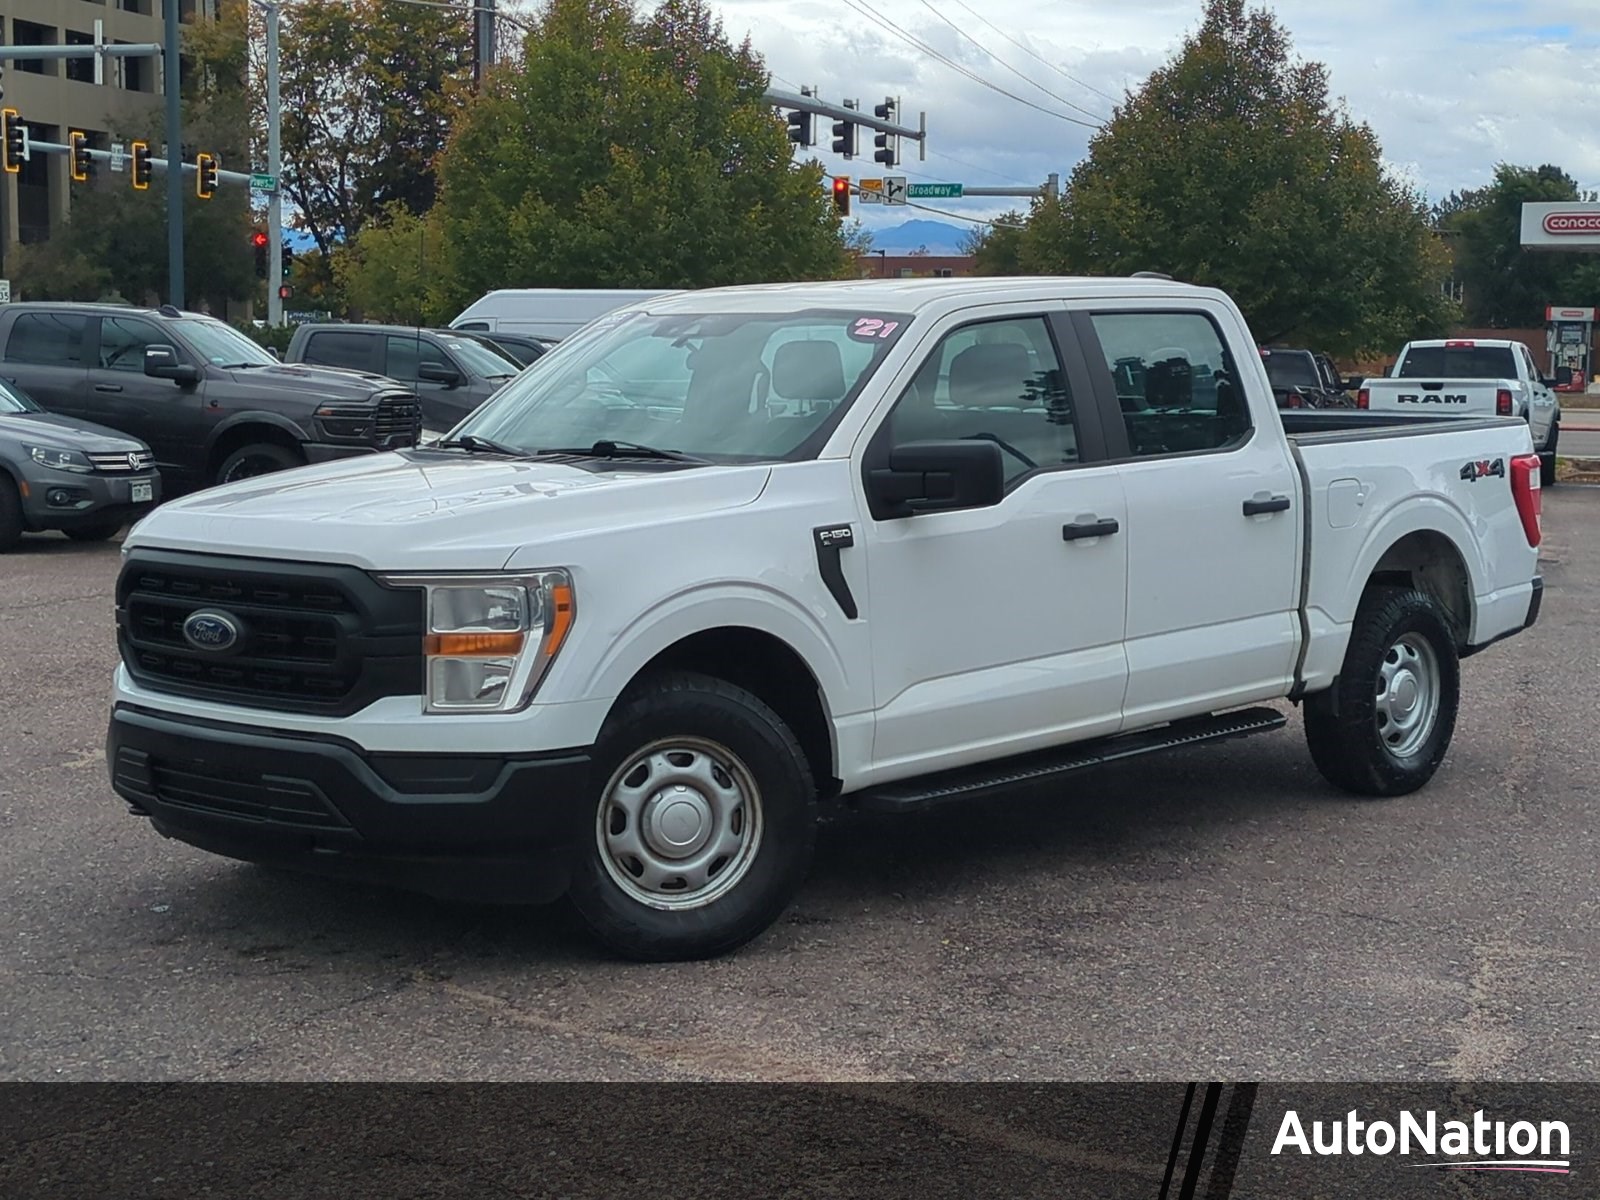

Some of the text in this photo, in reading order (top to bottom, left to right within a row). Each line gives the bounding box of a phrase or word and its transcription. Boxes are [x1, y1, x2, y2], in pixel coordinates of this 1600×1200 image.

[908, 185, 951, 196] Broadway
[1397, 395, 1467, 403] RAM
[820, 529, 851, 540] F-150
[194, 620, 223, 642] Ford
